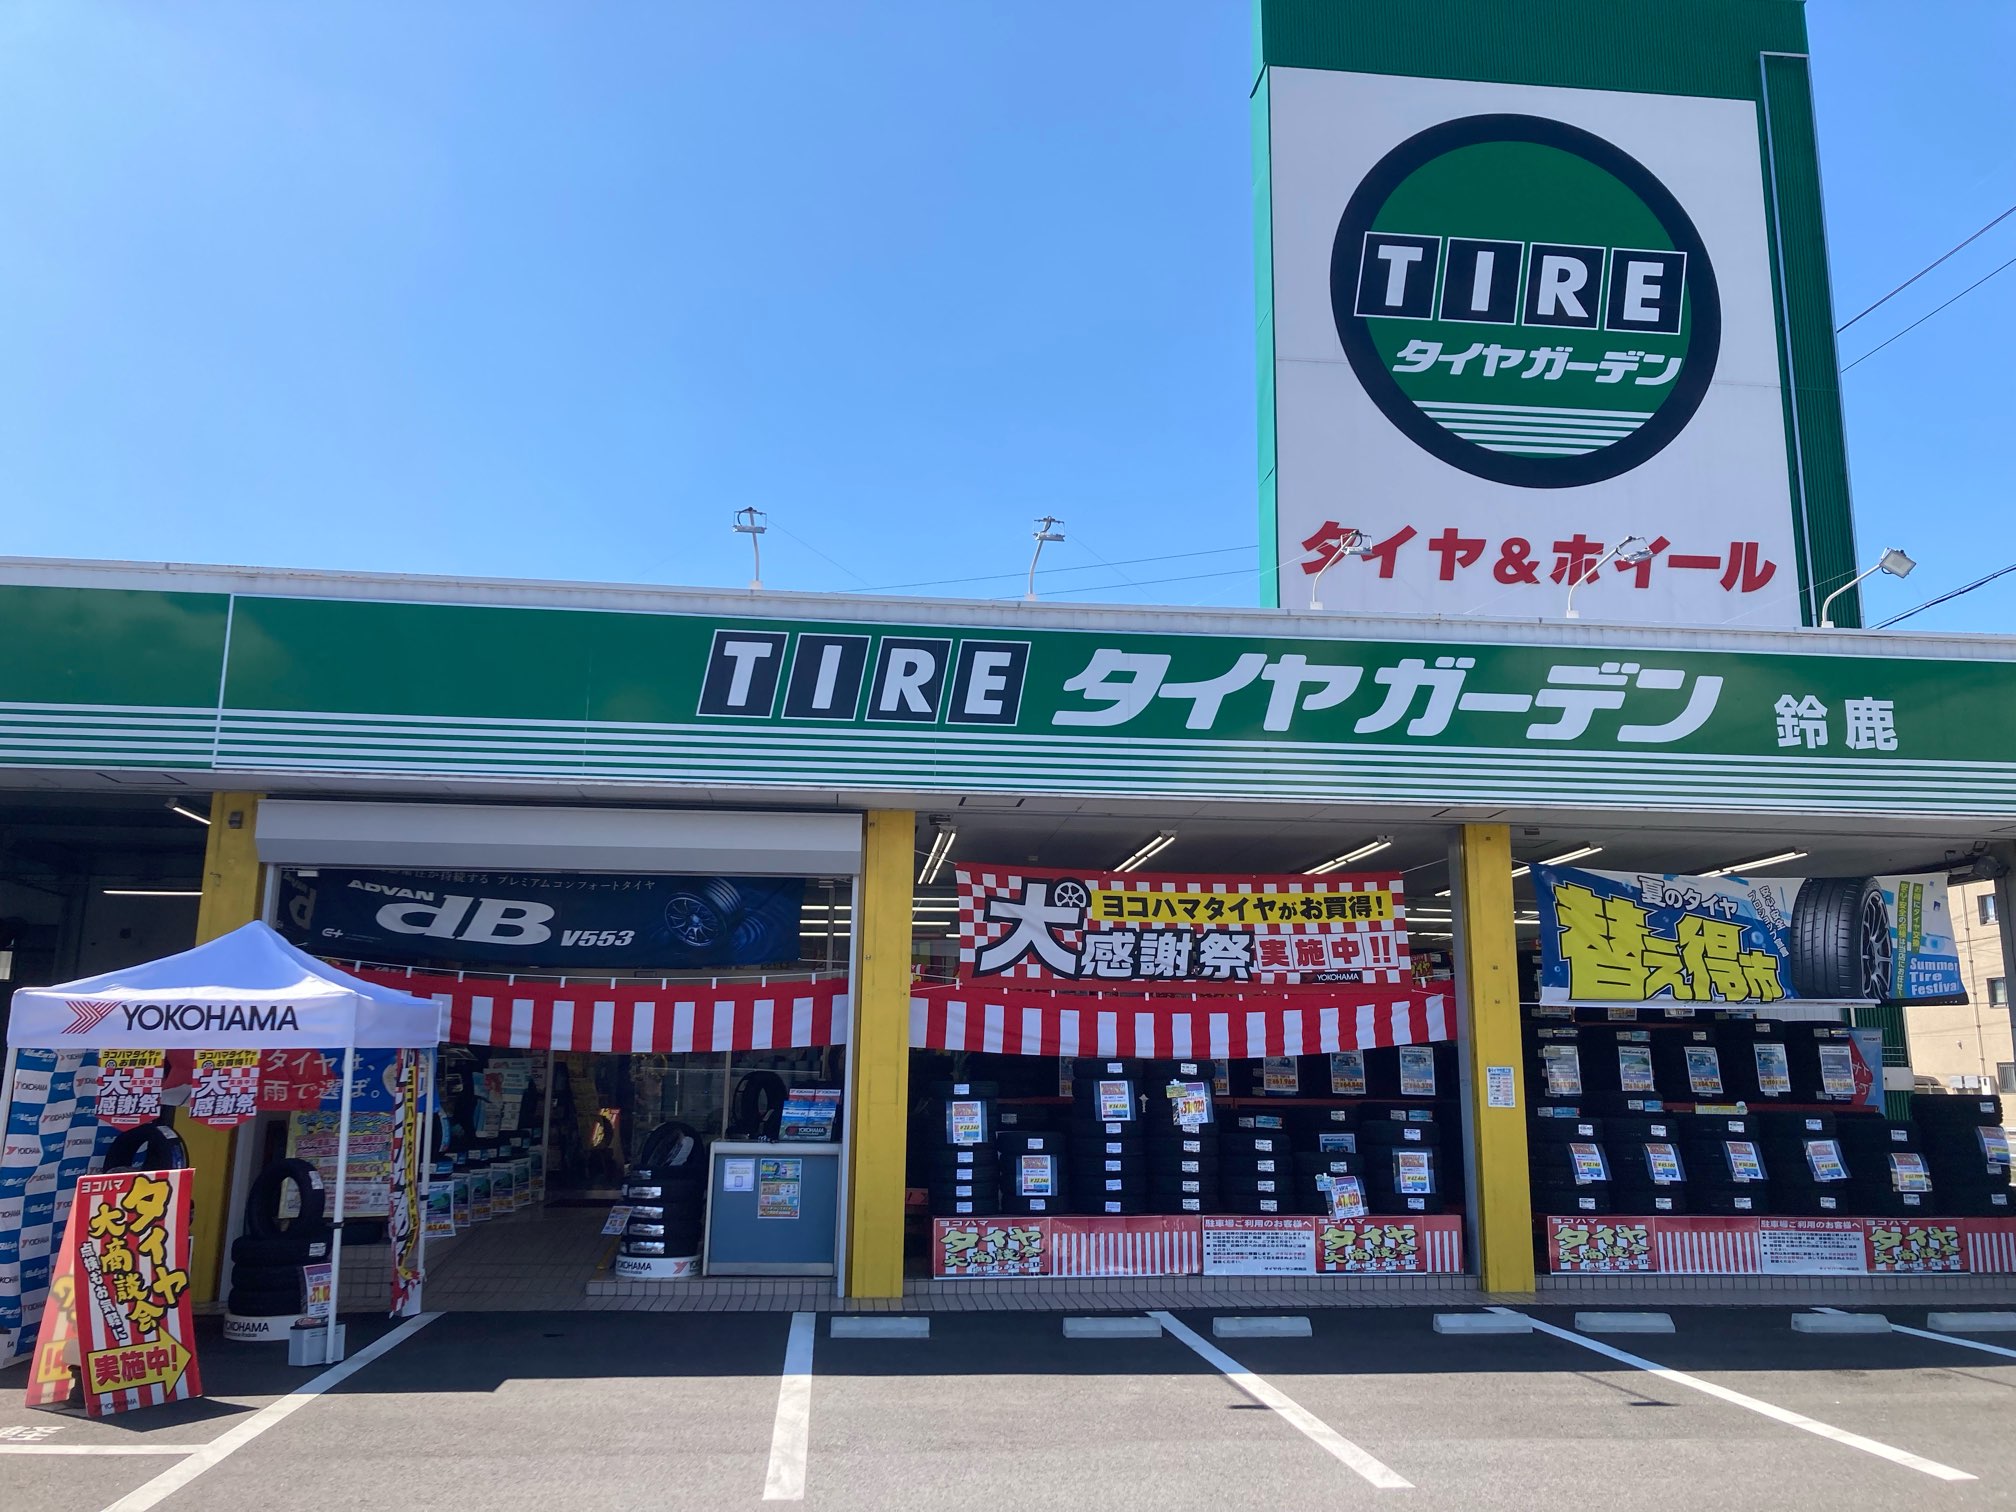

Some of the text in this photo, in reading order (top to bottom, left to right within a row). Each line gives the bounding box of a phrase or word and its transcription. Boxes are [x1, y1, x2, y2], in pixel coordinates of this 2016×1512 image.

[1377, 244, 1664, 322] TIRE
[1392, 339, 1683, 386] タイヤガーデン
[1301, 520, 1777, 593] タイヤ&ホイール
[723, 640, 1013, 715] TIRE
[1052, 648, 1724, 742] タイヤガーデン
[1774, 694, 1898, 751] 鈴鹿
[347, 879, 435, 901] ADVAN
[1638, 875, 1739, 919] 夏のタイヤ
[375, 894, 555, 946] dB
[1102, 895, 1384, 922] ヨコハマタイヤがお買得!
[560, 929, 635, 947] V553
[979, 882, 1080, 976] 大
[1080, 931, 1251, 979] 感謝祭
[1909, 956, 1958, 971] Summer
[1317, 973, 1359, 981] YOKOHAMA
[1909, 972, 1942, 982] Tire
[1911, 982, 1960, 996] Festival
[122, 1005, 299, 1031] YOKOHAMA
[101, 1069, 131, 1096] 大
[198, 1069, 229, 1096] 大
[98, 1094, 160, 1116] 感謝祭
[193, 1094, 256, 1116] 感謝祭
[82, 1179, 124, 1194] ヨコハマ
[122, 1174, 188, 1306] タイヤ
[939, 1227, 1044, 1254] タイヤ
[1319, 1226, 1419, 1251] タイヤ
[1553, 1226, 1649, 1250] タイヤ
[1868, 1227, 1959, 1252] タイヤ
[89, 1203, 165, 1335] 大商談会
[95, 1344, 177, 1387] 実施中!
